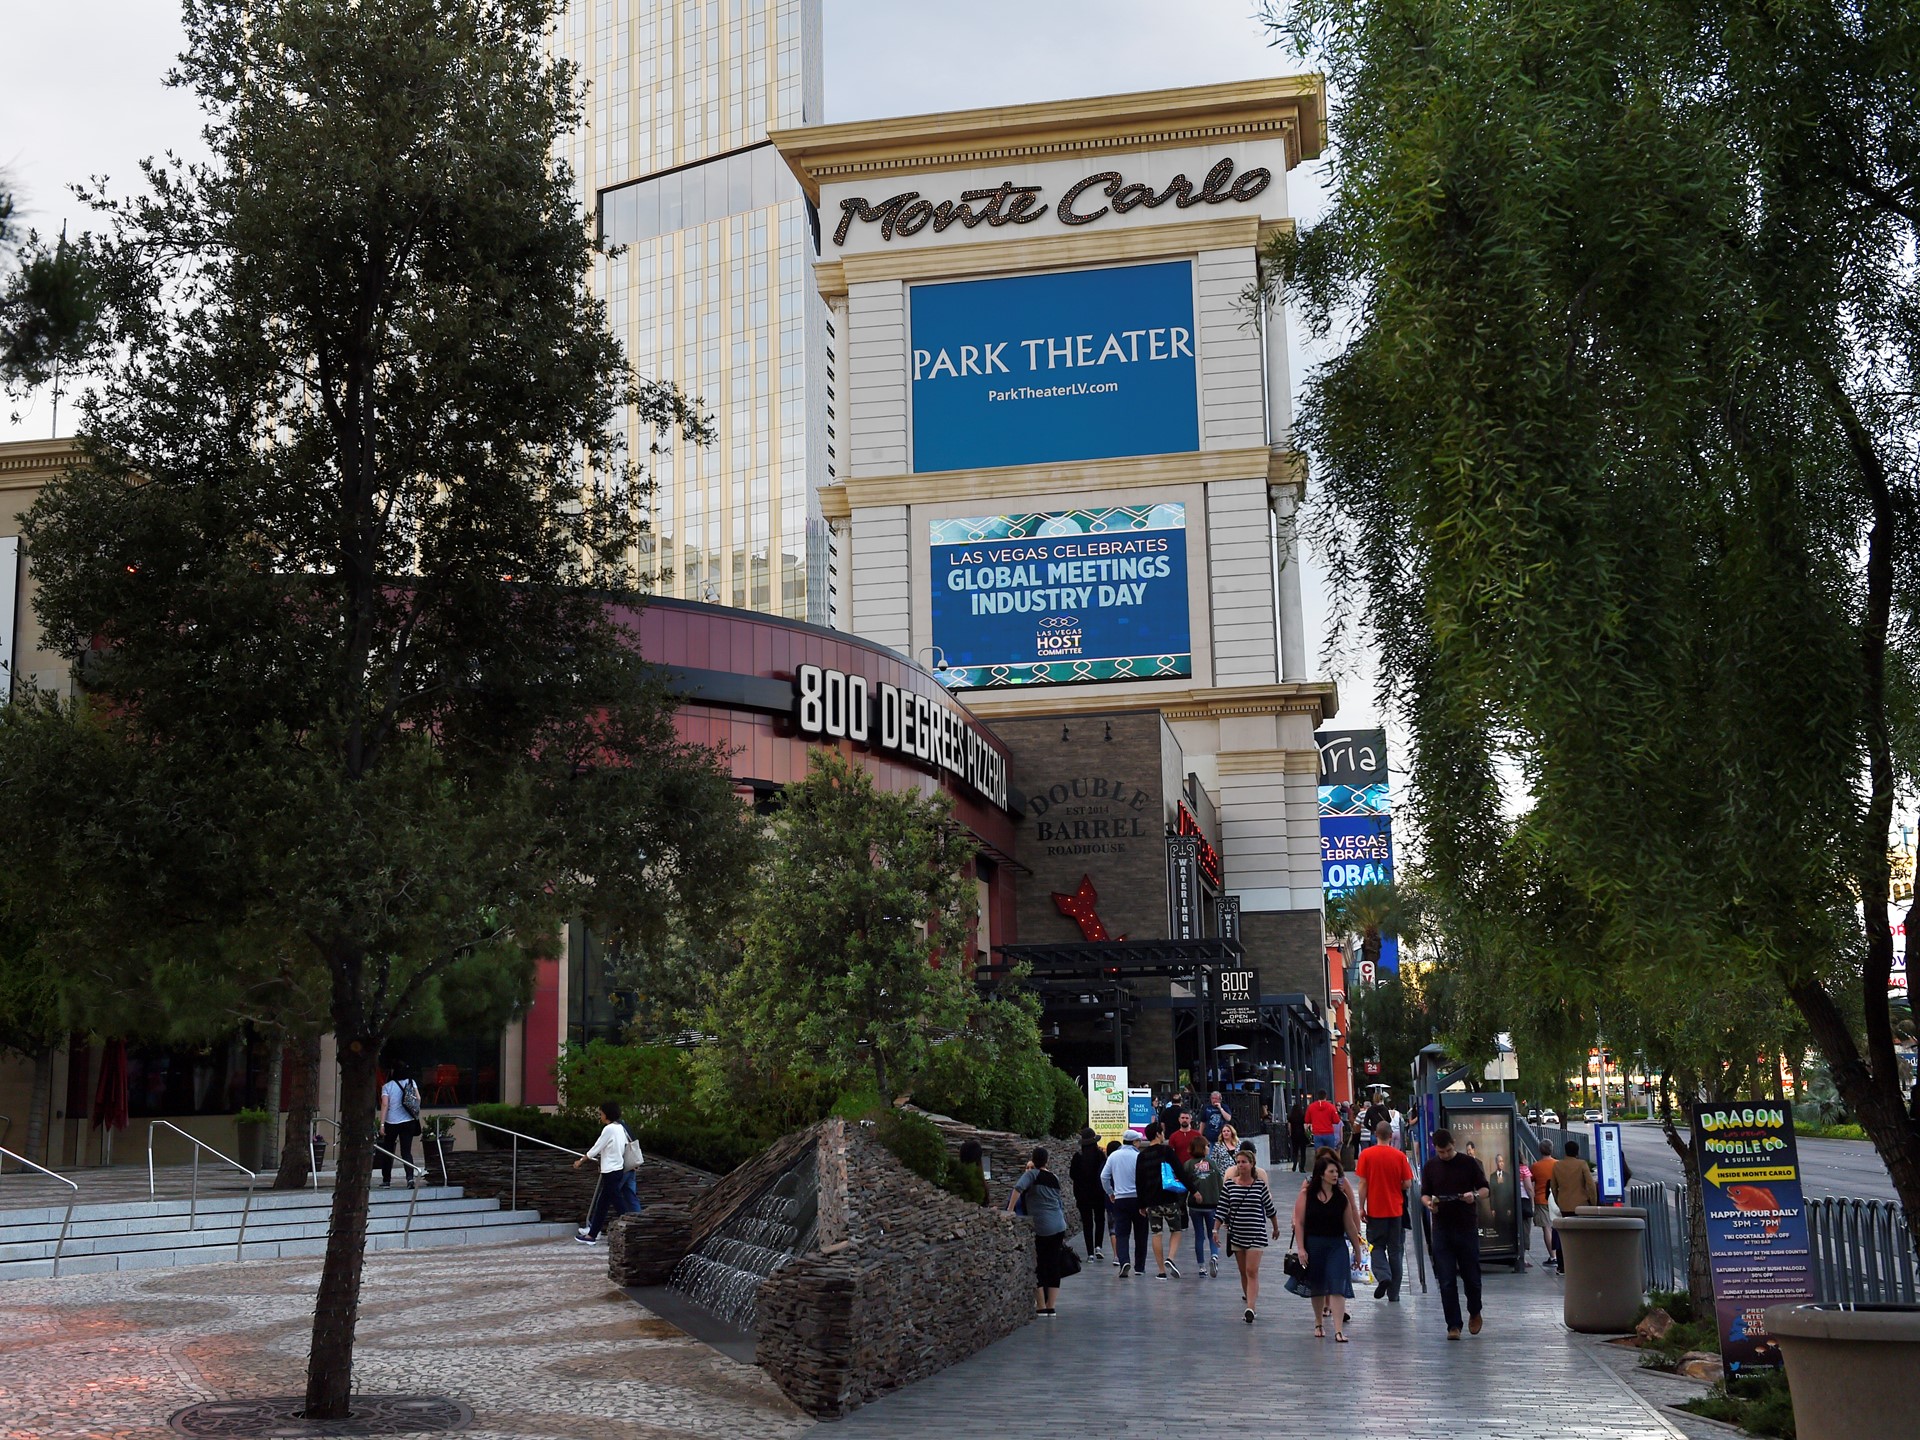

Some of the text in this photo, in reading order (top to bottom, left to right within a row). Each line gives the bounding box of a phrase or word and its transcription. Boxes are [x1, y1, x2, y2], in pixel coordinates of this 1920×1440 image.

[833, 157, 1271, 246] Monte Carlo
[913, 327, 1194, 380] PARK THEATER
[988, 380, 1118, 402] ParkTheaterLV.com
[951, 539, 1168, 565] LAS VEGAS CELEBRATES
[948, 556, 1170, 590] GLOBAL MEETINGS
[972, 583, 1147, 615] INDUSTRY DAY
[1037, 635, 1082, 649] HOST
[1038, 648, 1082, 656] COMMITTEE
[799, 664, 1008, 812] 800 DEGREES PIZZERIA
[1028, 778, 1149, 817] DOUBLE
[1066, 806, 1109, 816] EST 2014
[1037, 818, 1145, 841] BARREL
[1048, 844, 1125, 856] ROADHOUSE
[1334, 835, 1387, 848] VEGAS
[1178, 859, 1189, 922] WATERING
[1700, 1109, 1784, 1130] DRAGON
[1705, 1139, 1788, 1154] NOODLE CO.
